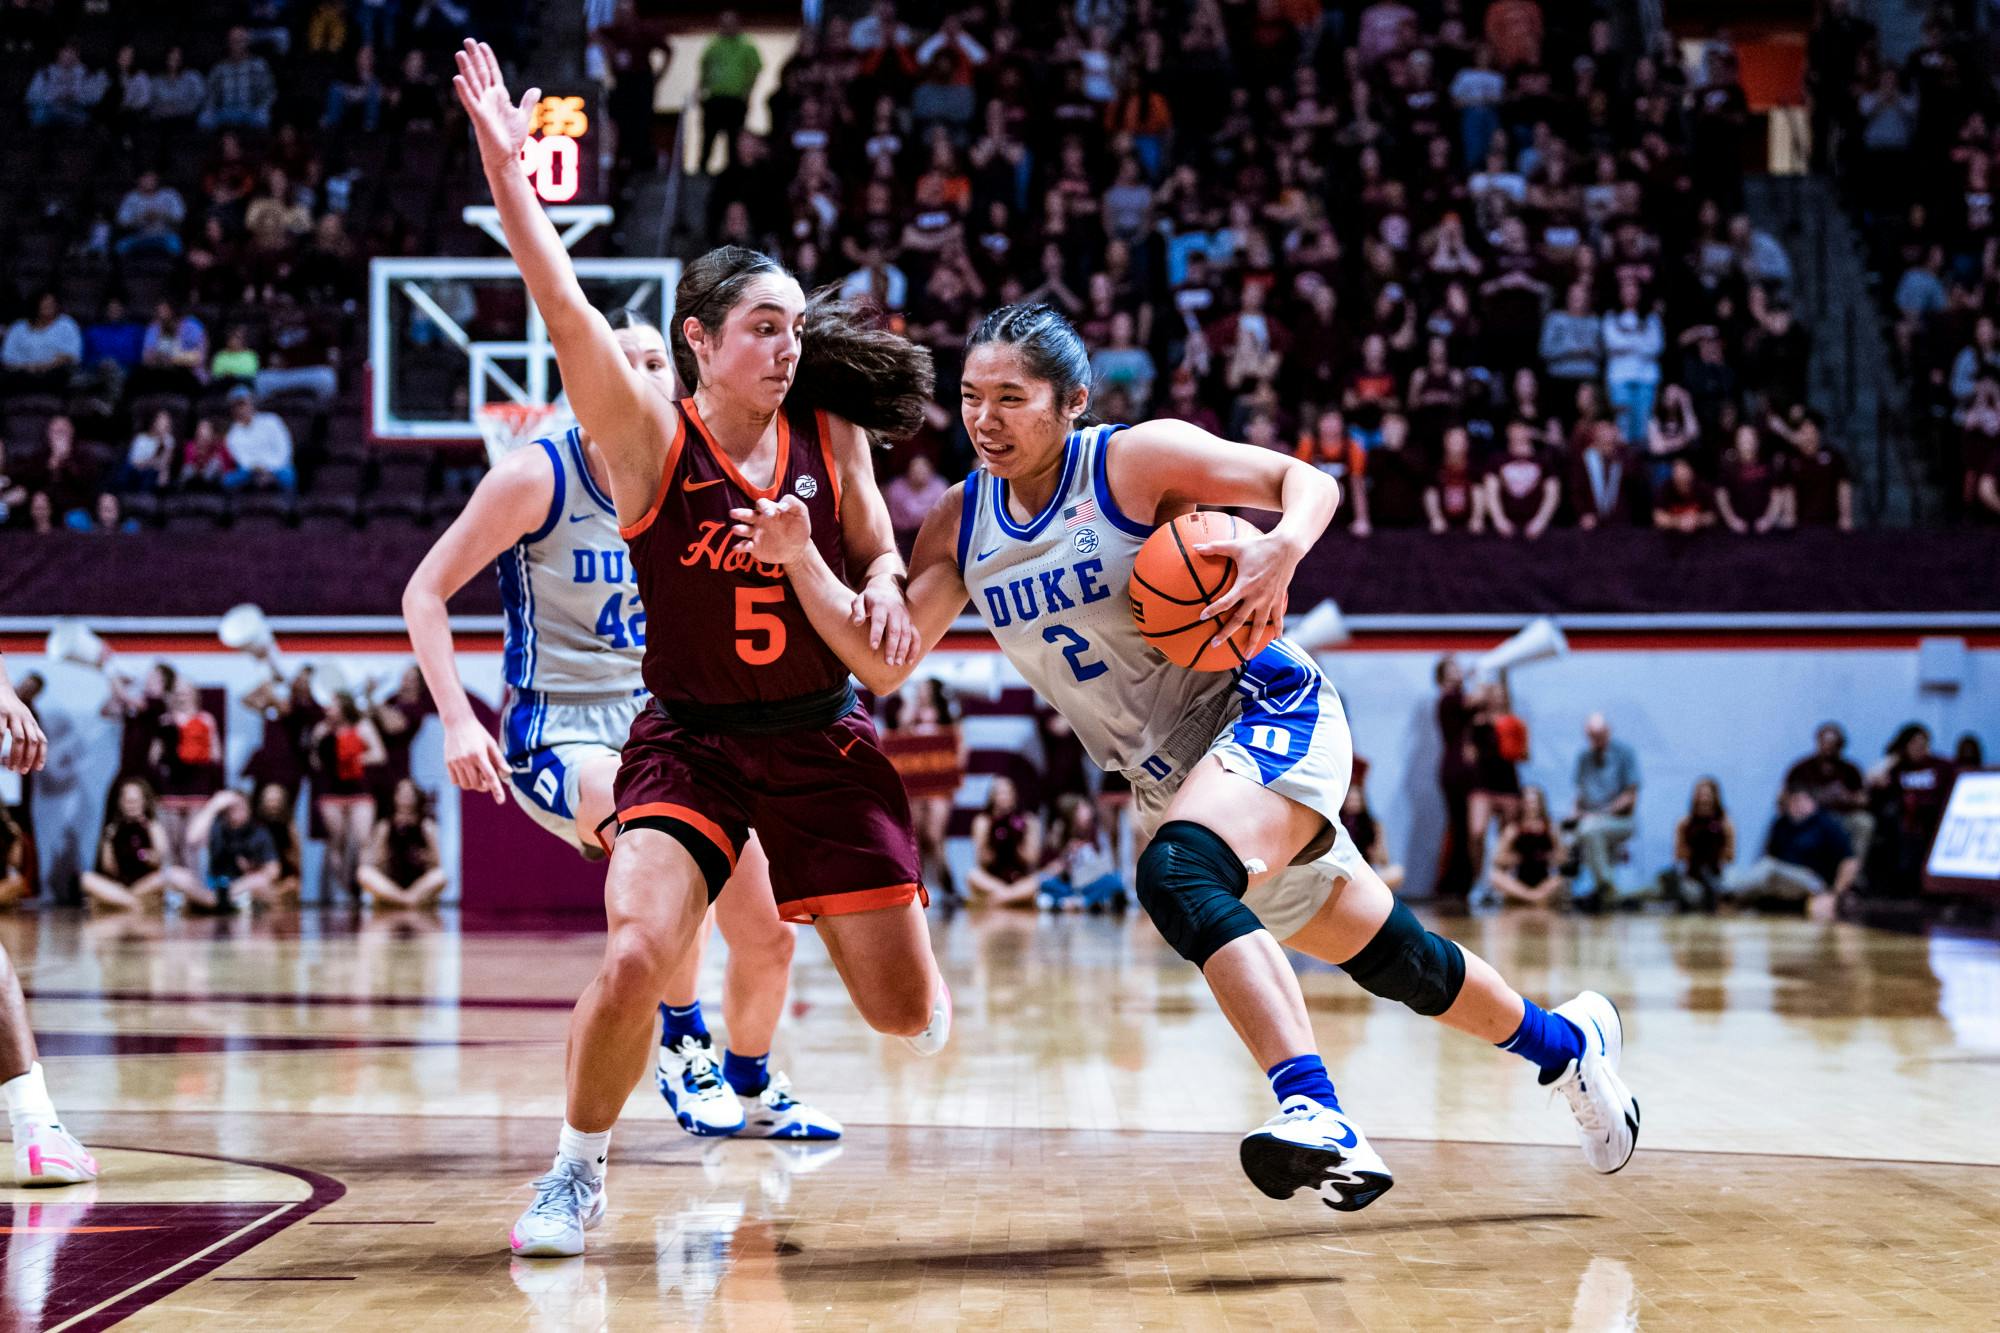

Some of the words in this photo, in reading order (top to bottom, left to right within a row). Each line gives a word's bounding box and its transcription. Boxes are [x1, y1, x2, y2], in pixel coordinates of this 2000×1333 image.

[596, 592, 647, 649] 42
[984, 558, 1111, 628] DUKE
[735, 585, 787, 666] 5
[1042, 624, 1109, 682] 2
[1140, 754, 1173, 782] D
[1250, 725, 1291, 757] D
[533, 767, 558, 808] D
